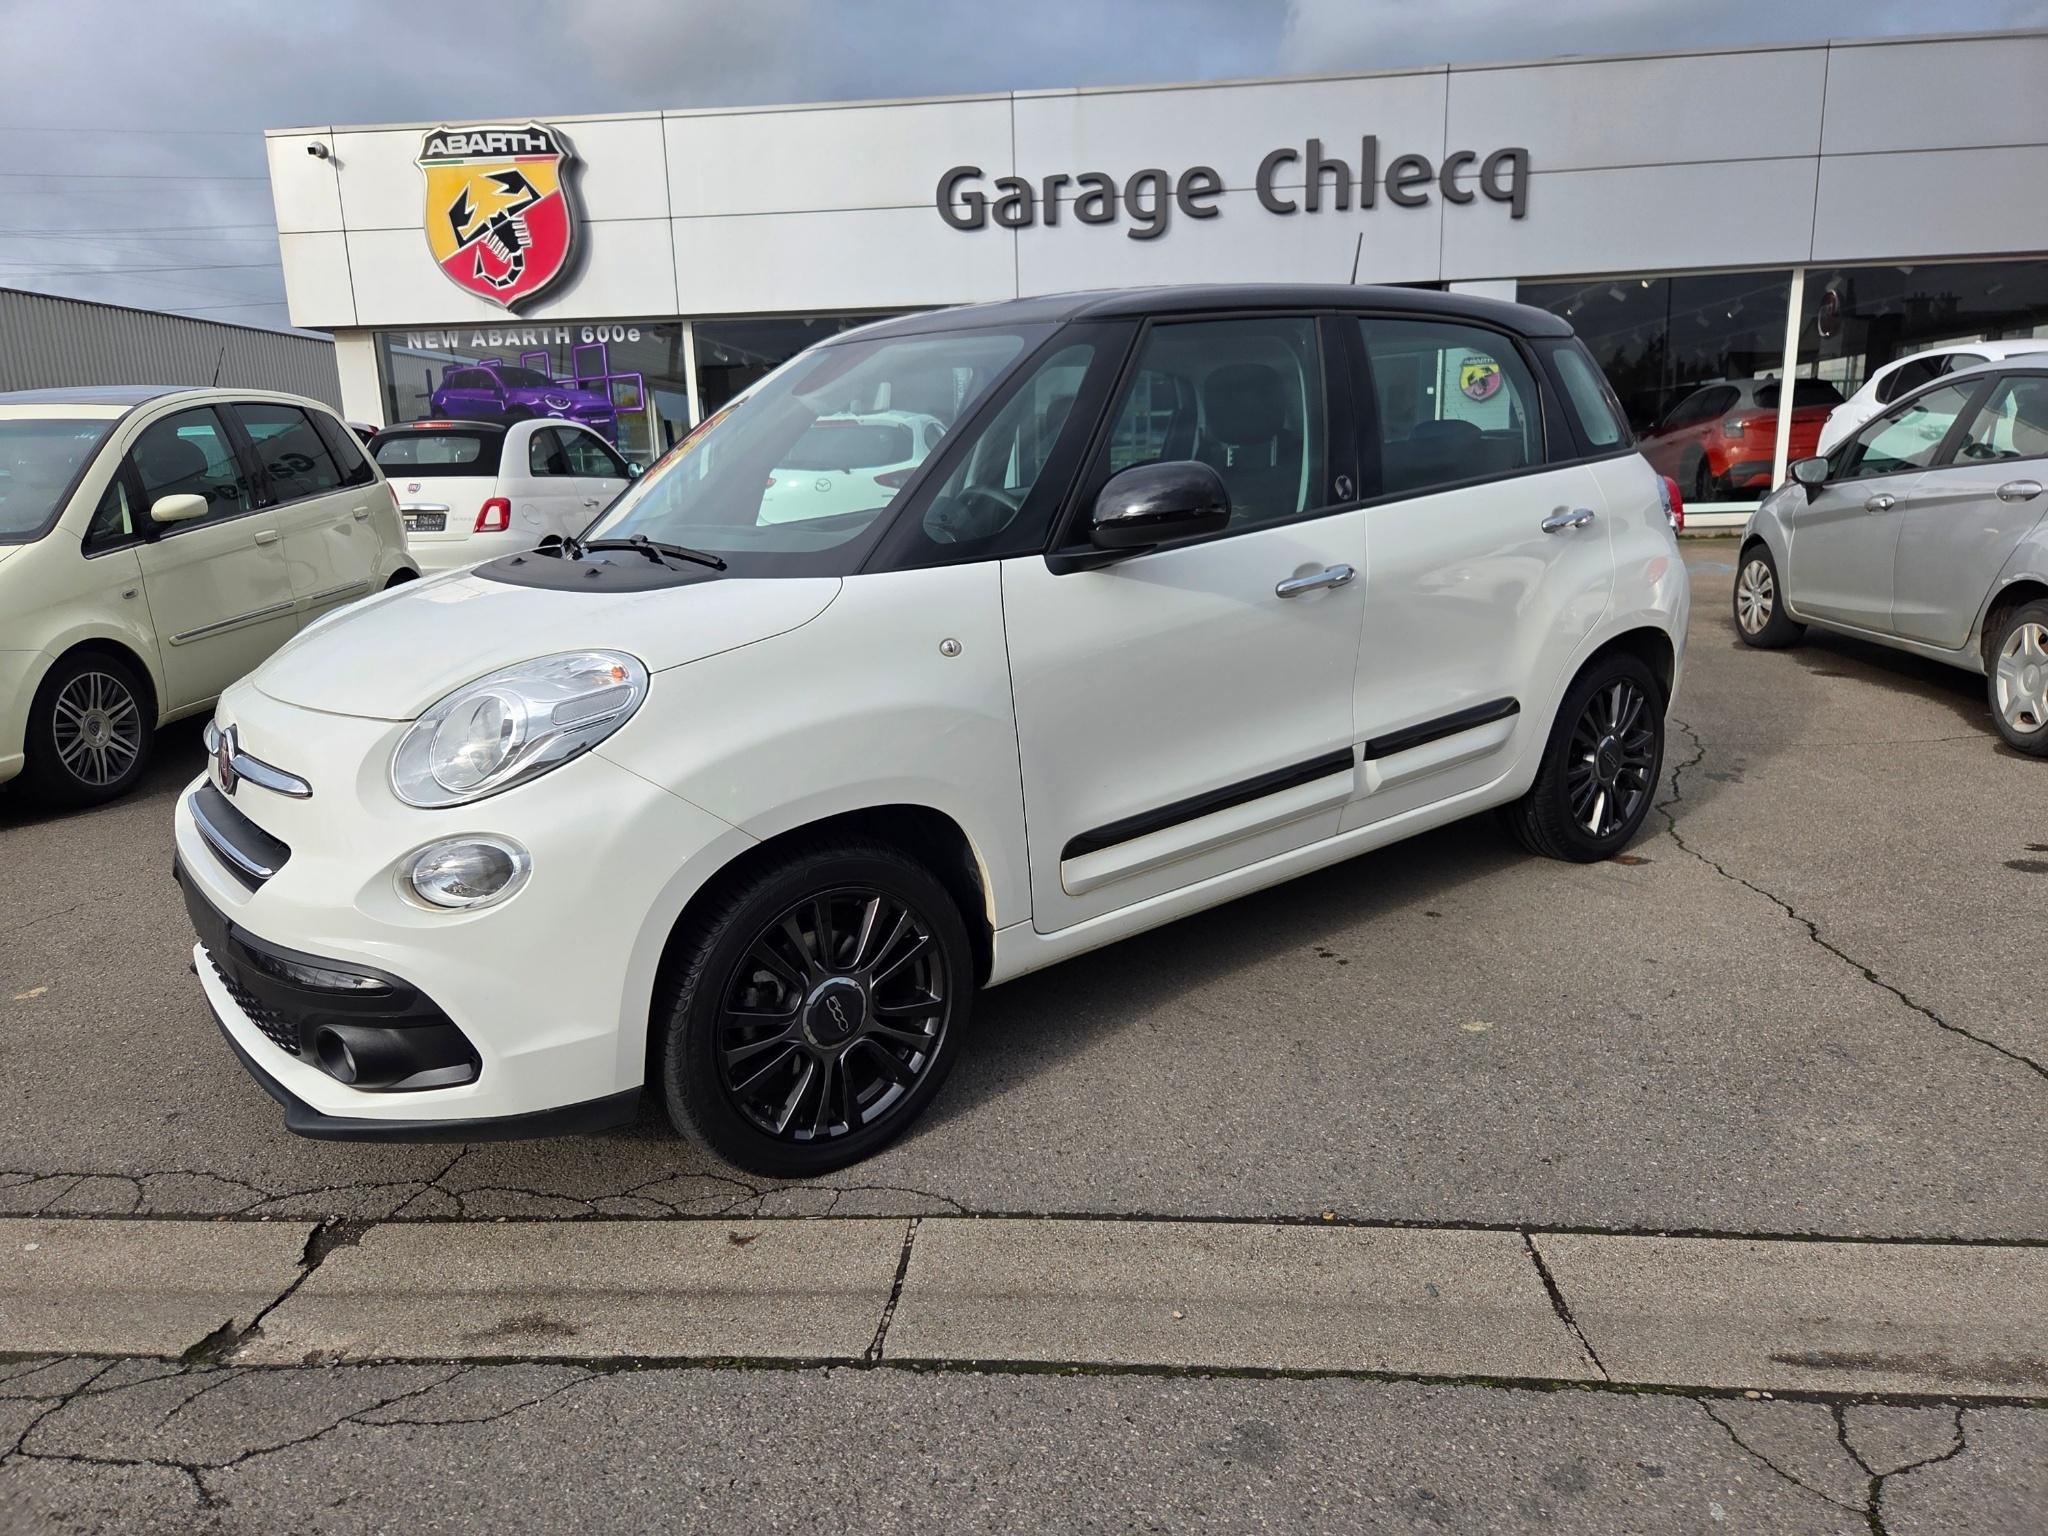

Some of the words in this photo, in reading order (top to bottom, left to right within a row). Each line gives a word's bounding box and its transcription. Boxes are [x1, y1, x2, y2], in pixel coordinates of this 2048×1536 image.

[428, 133, 546, 155] ABARTH
[936, 166, 1222, 240] Garage
[1256, 134, 1530, 219] Chlecq
[407, 331, 459, 349] NEW
[471, 327, 571, 348] ABARTH
[581, 325, 641, 344] 600e
